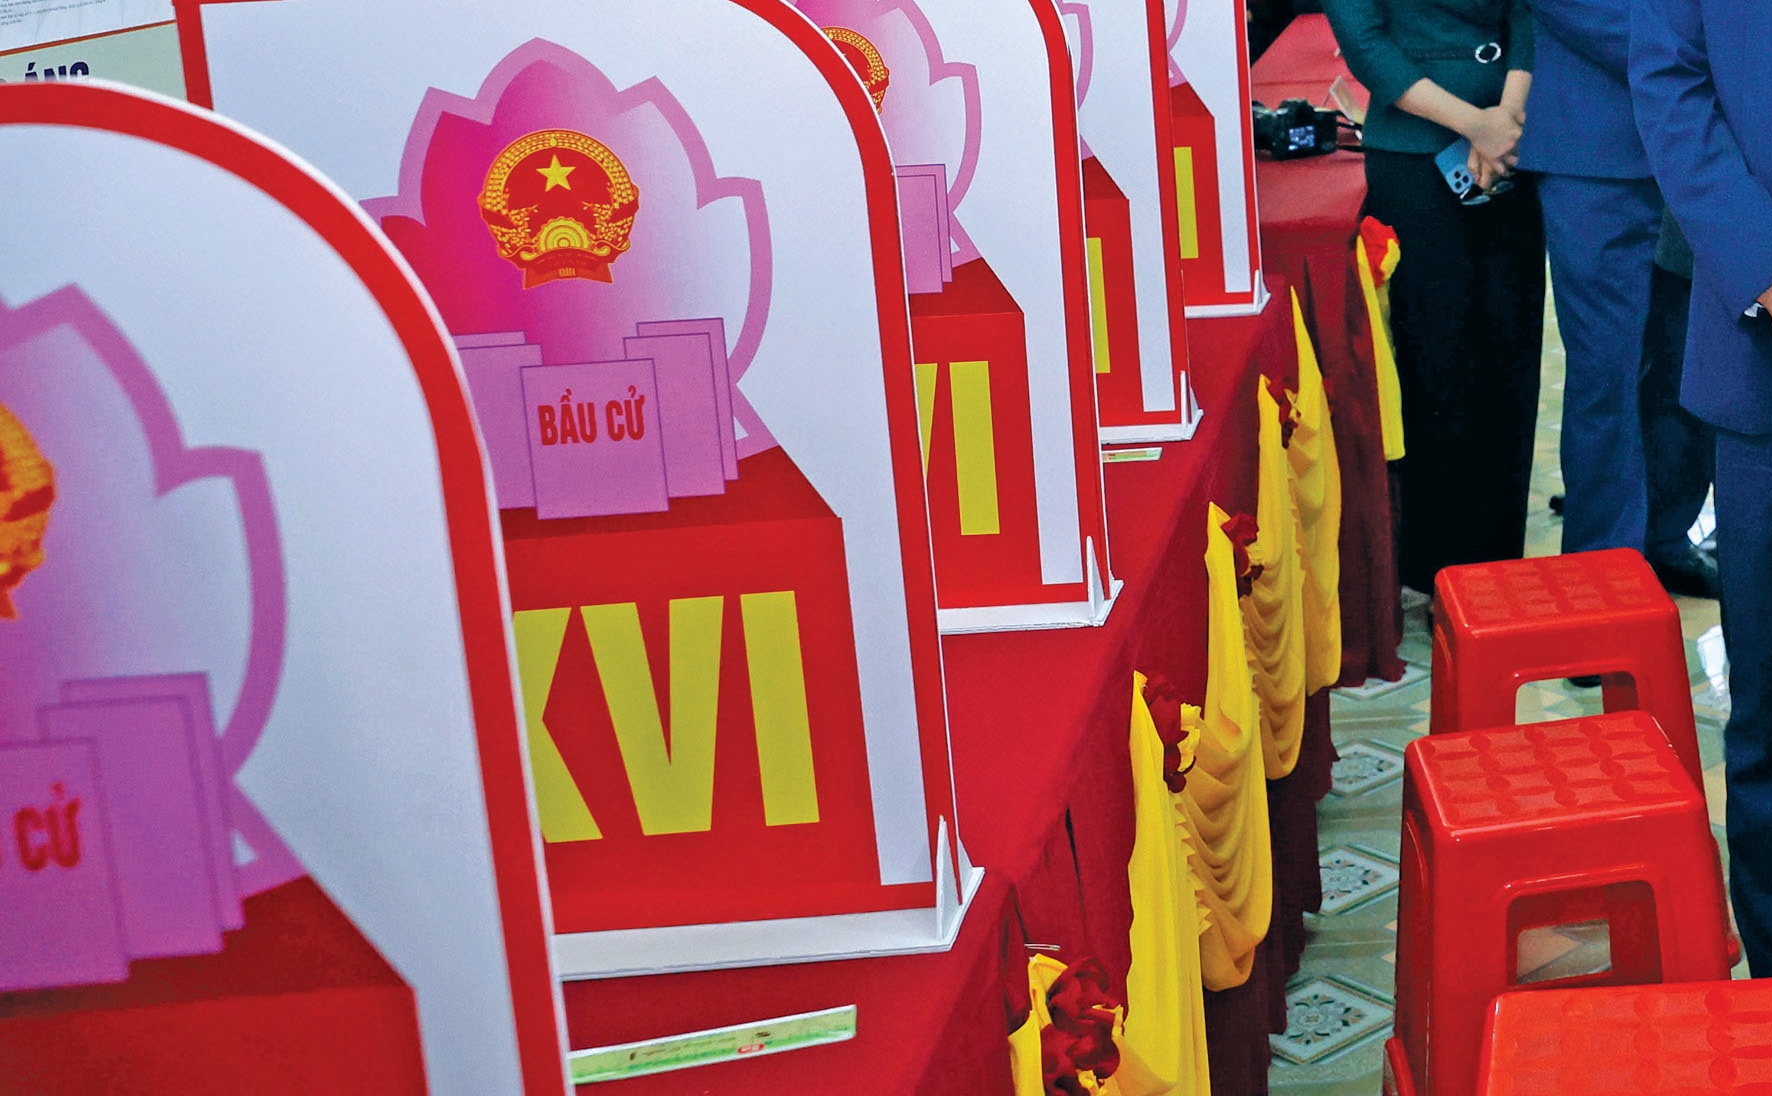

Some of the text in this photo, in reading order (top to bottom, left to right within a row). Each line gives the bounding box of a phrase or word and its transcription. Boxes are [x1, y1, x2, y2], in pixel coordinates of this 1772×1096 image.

[538, 384, 647, 446] BẦU CỬ
[13, 782, 82, 872] CỬ
